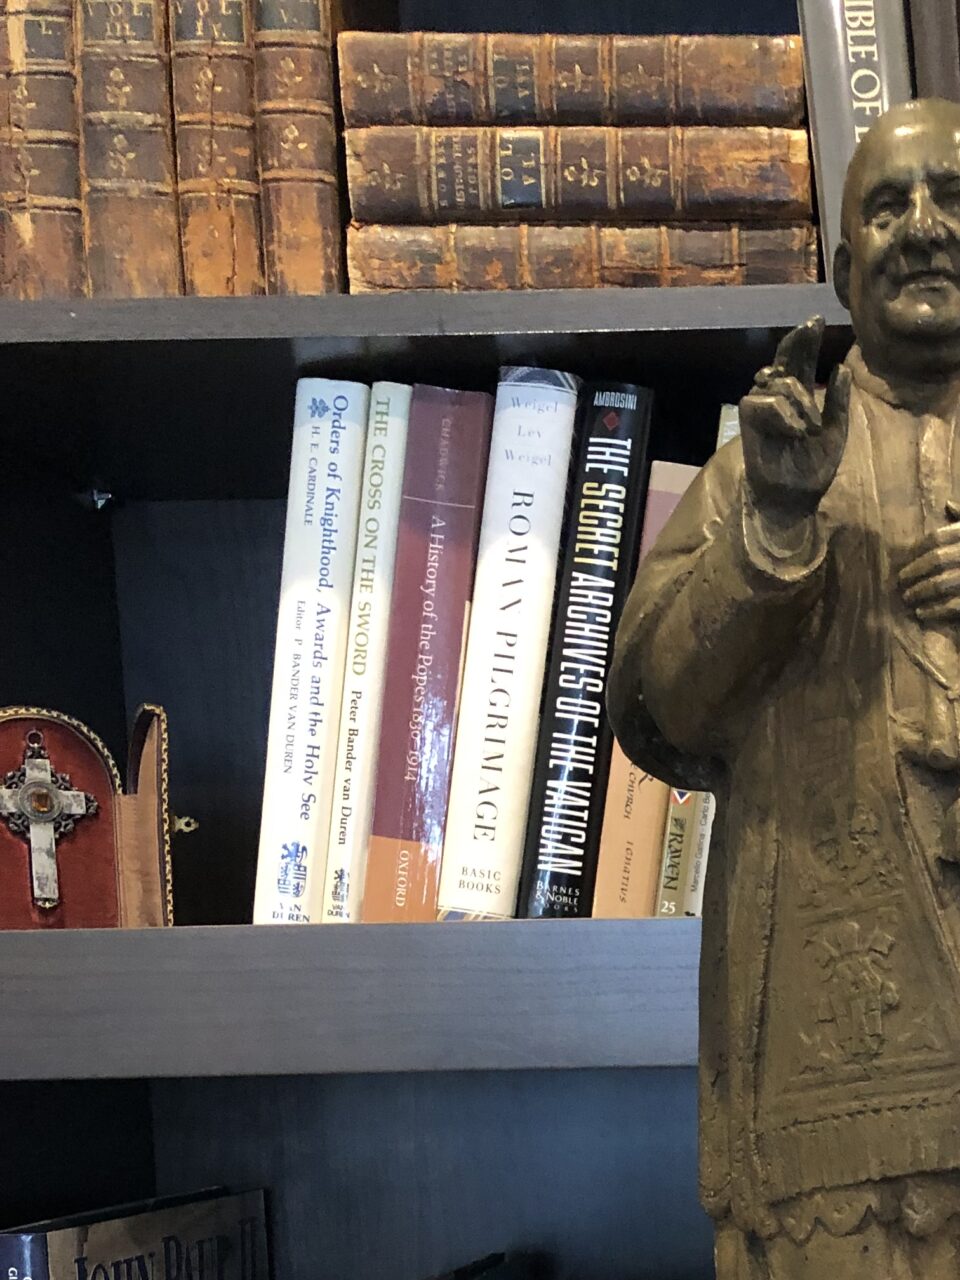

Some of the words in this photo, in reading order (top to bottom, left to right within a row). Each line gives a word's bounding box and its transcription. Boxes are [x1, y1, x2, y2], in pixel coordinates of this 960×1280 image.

[850, 69, 882, 117] OF
[373, 397, 390, 437] THE
[511, 396, 559, 415] Weigel
[593, 391, 637, 411] AMBROSINI
[328, 394, 349, 455] Orders
[326, 461, 342, 481] of
[367, 443, 386, 510] CROSS
[504, 449, 553, 467] Weigel
[585, 437, 632, 477] THE
[303, 457, 318, 526] CARDINALE
[316, 485, 342, 593] Knighthood,
[364, 517, 380, 550] ON
[431, 514, 447, 529] A
[573, 481, 627, 572] SECRET
[420, 531, 445, 596] History
[499, 488, 534, 612] ROMAN
[359, 555, 376, 594] THE
[424, 600, 440, 618] of
[310, 602, 331, 669] Awards
[351, 601, 371, 676] SWORD
[418, 622, 437, 650] the
[559, 571, 616, 693] ARCHIVES
[309, 674, 324, 708] and
[412, 654, 433, 706] Popes
[307, 709, 324, 737] the
[349, 690, 363, 722] Peter
[555, 697, 601, 728] OF
[344, 727, 360, 773] Bander
[403, 707, 423, 782] 1830-1914
[473, 631, 518, 842] PILGRIMAGE
[549, 732, 597, 781] THE
[302, 744, 322, 786] Holy
[299, 792, 317, 821] See
[342, 781, 352, 802] van
[337, 806, 352, 845] Duren
[537, 779, 593, 876] VATICAN
[395, 849, 409, 907] OXFORD
[458, 880, 501, 895] BOOKS
[461, 866, 501, 882] BASIC
[546, 892, 578, 905] NOBLE
[660, 901, 676, 914] 25
